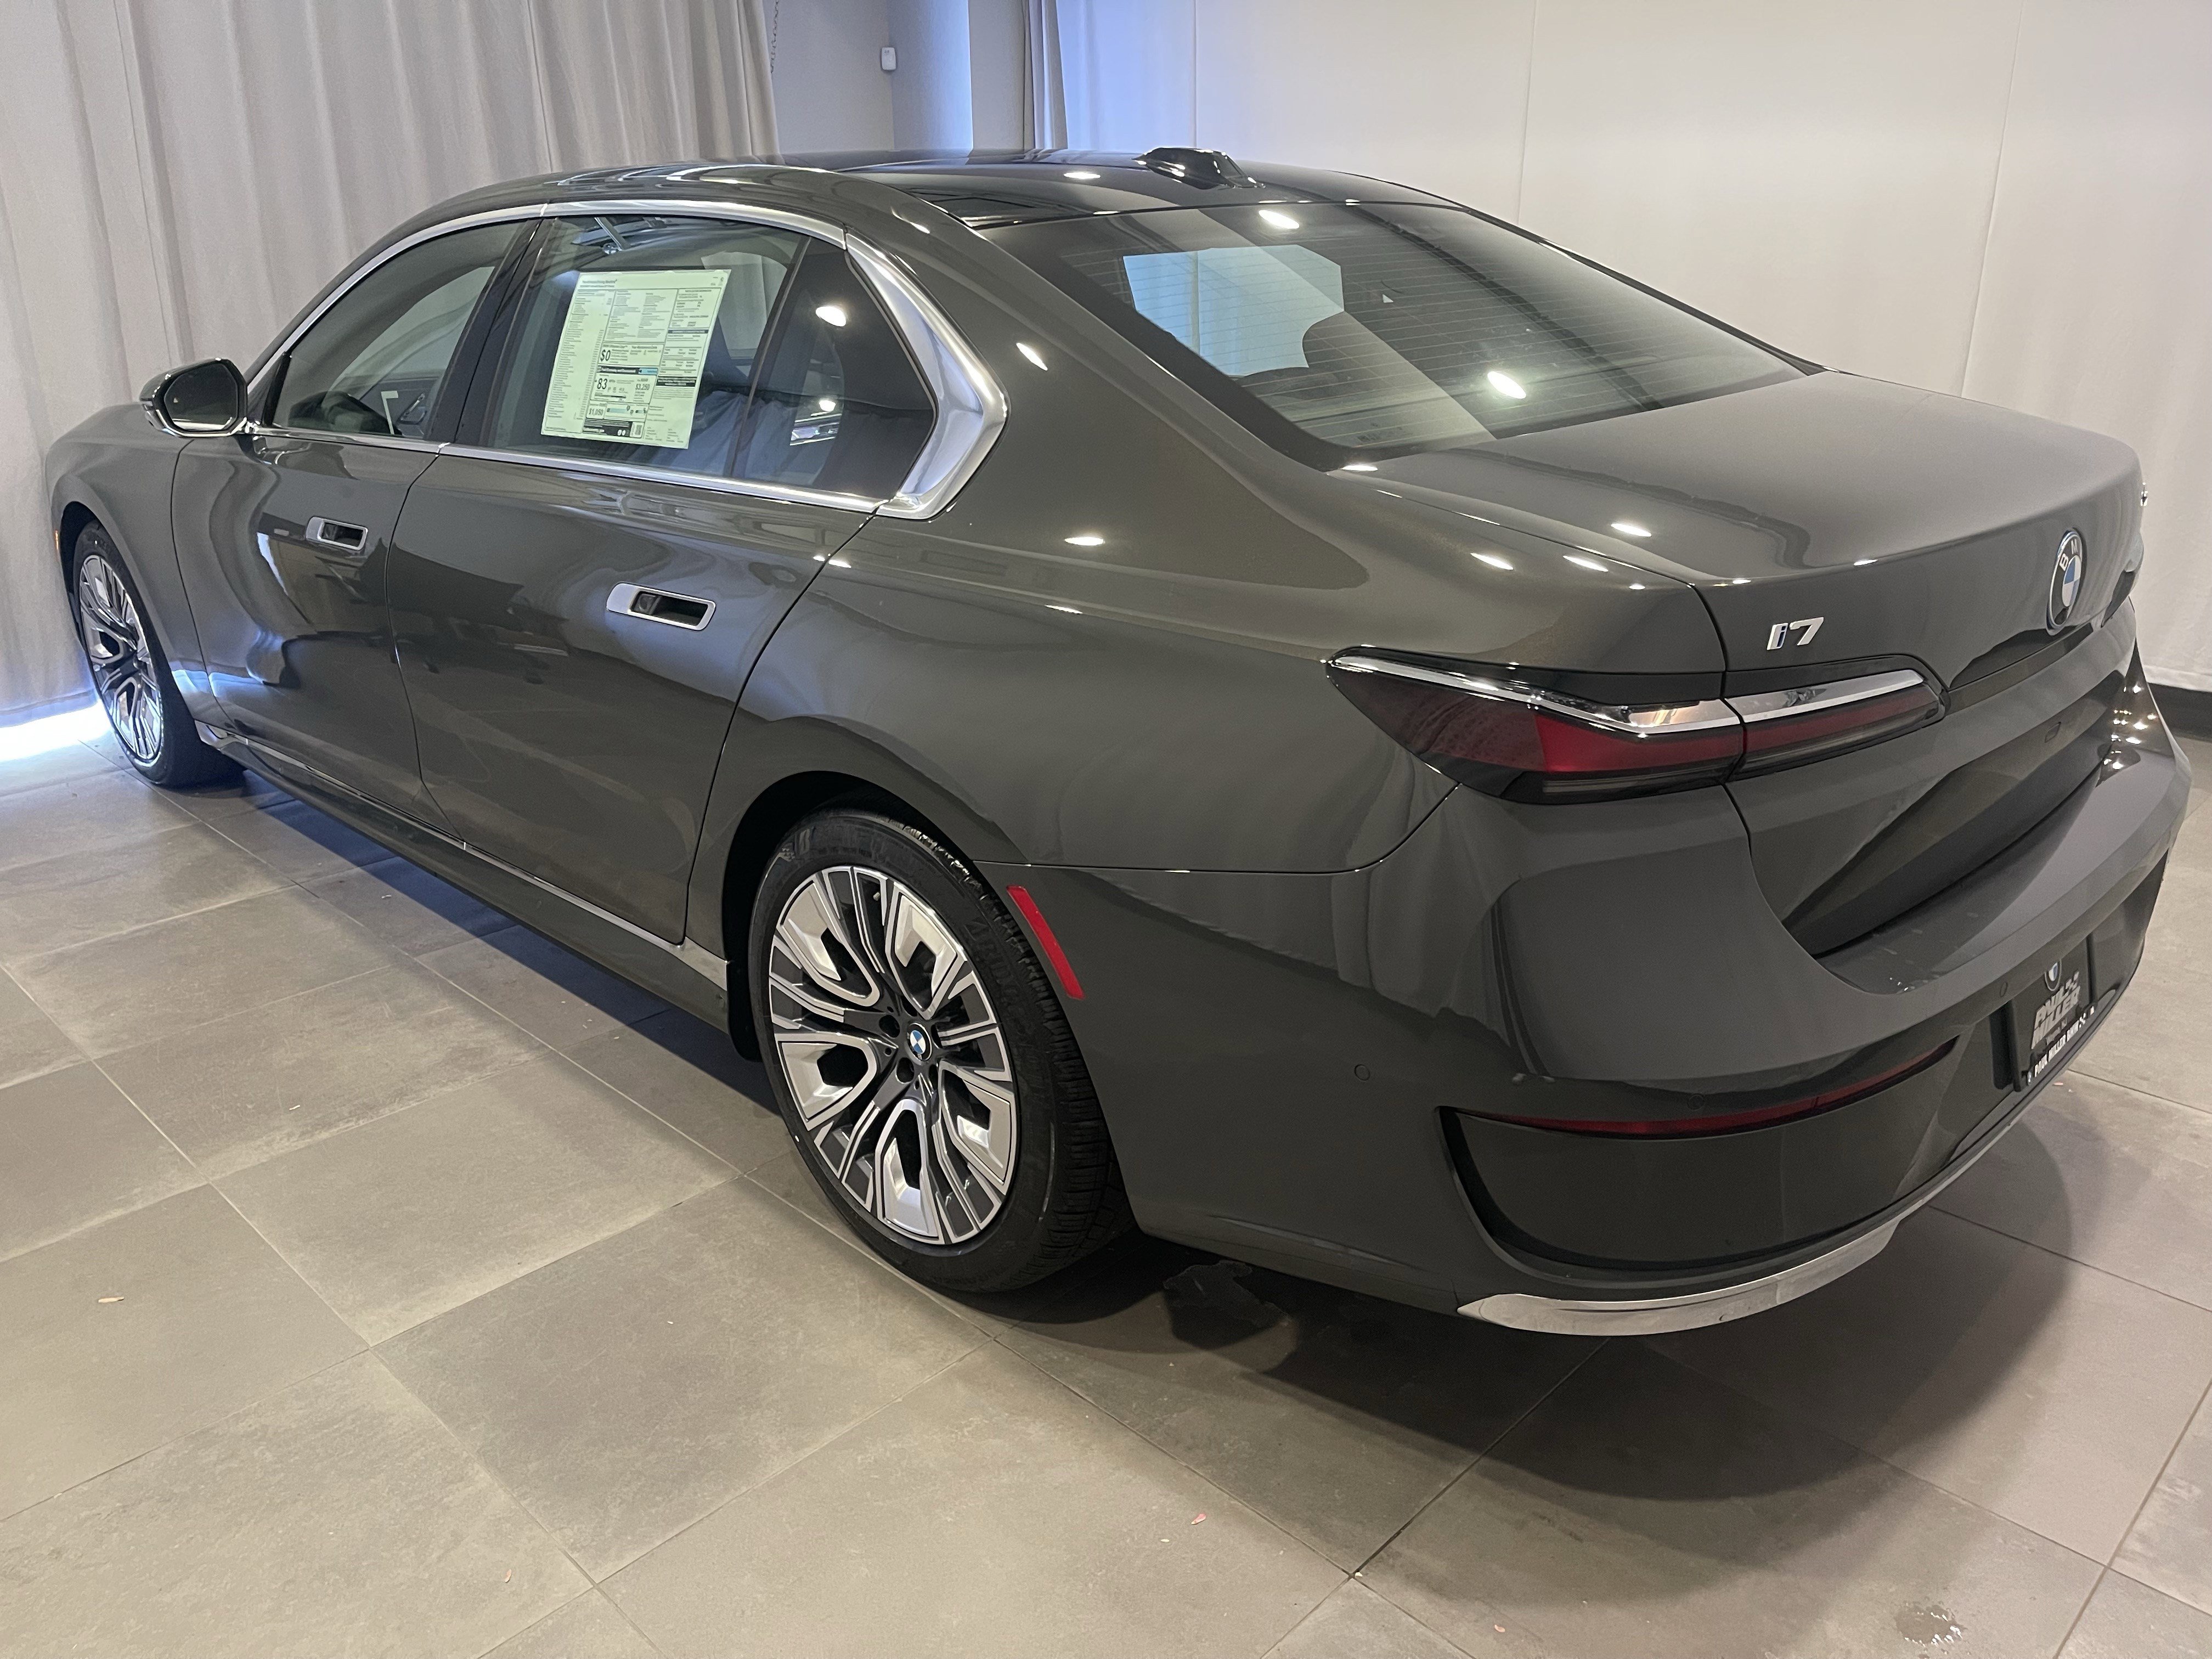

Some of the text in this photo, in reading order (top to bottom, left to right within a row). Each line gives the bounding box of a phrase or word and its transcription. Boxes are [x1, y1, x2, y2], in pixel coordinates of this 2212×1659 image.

[600, 349, 611, 362] $0
[597, 378, 608, 390] 83
[1767, 617, 1824, 650] i7
[2032, 986, 2081, 1049] MILLER
[2034, 985, 2069, 1030] PAUL
